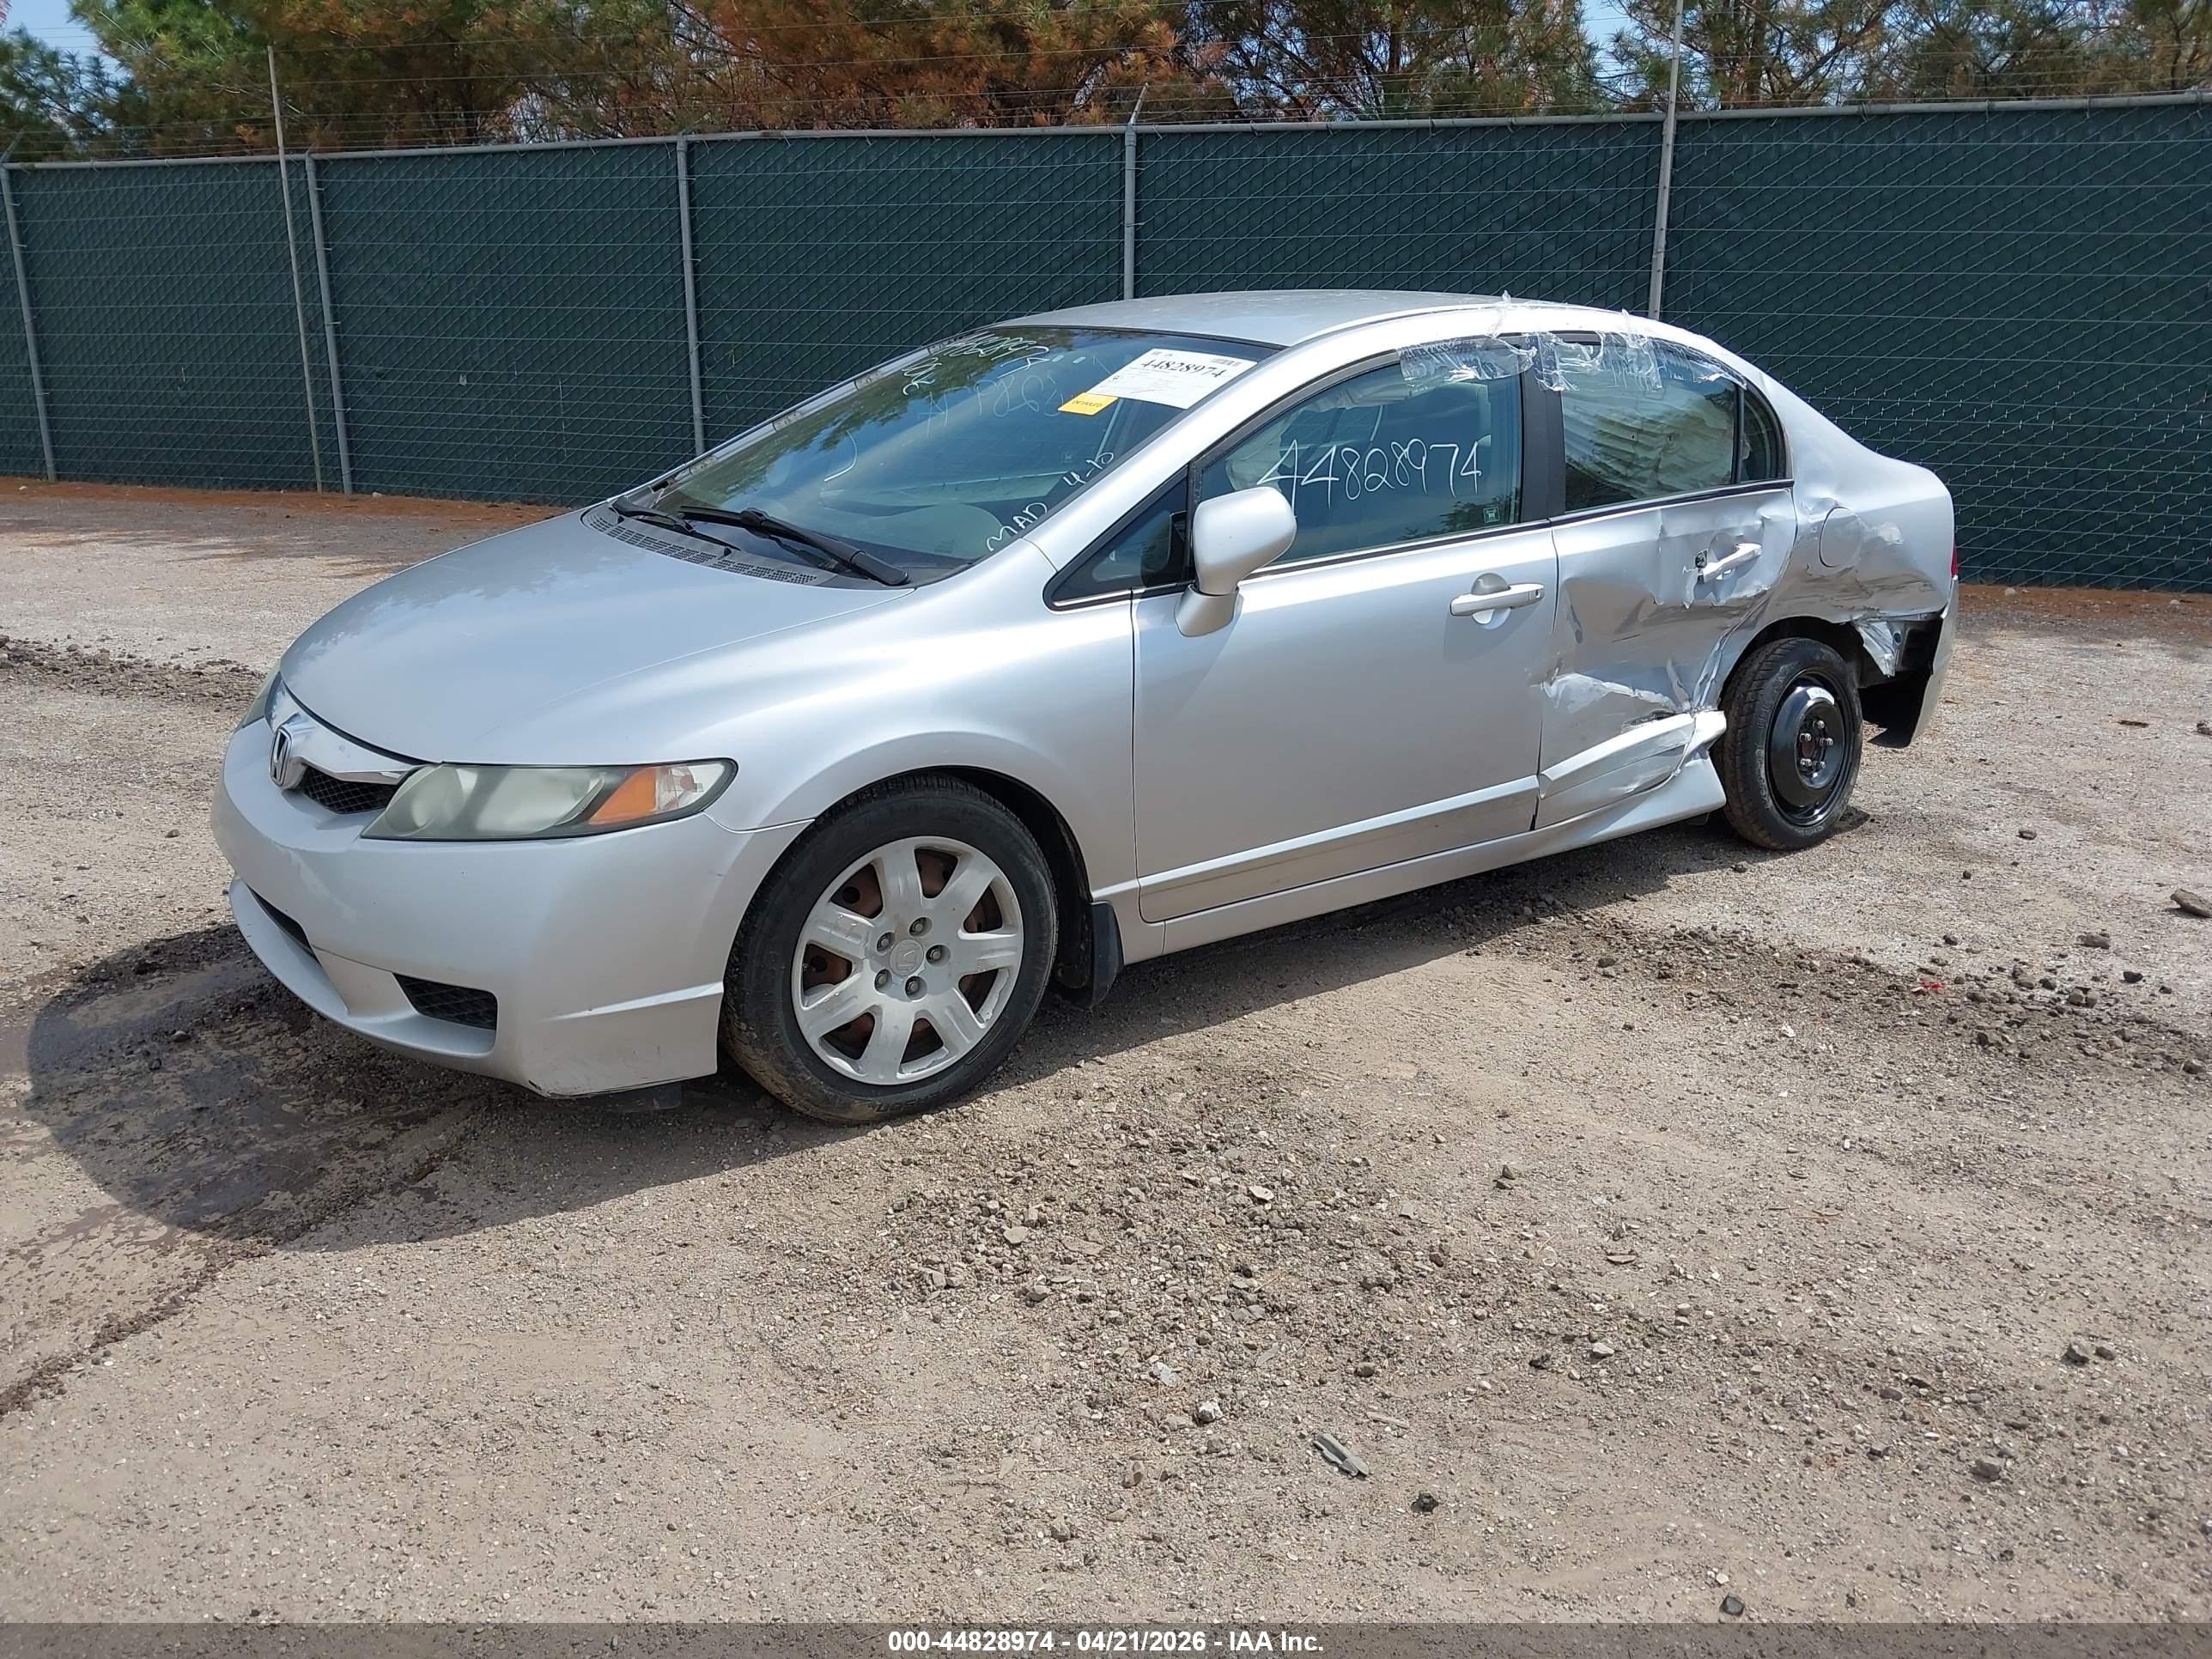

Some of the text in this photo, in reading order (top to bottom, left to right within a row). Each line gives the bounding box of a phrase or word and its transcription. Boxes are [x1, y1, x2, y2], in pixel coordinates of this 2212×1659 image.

[1141, 359, 1227, 378] 44828974
[1256, 438, 1482, 518] 44828974
[986, 502, 1048, 551] MAD
